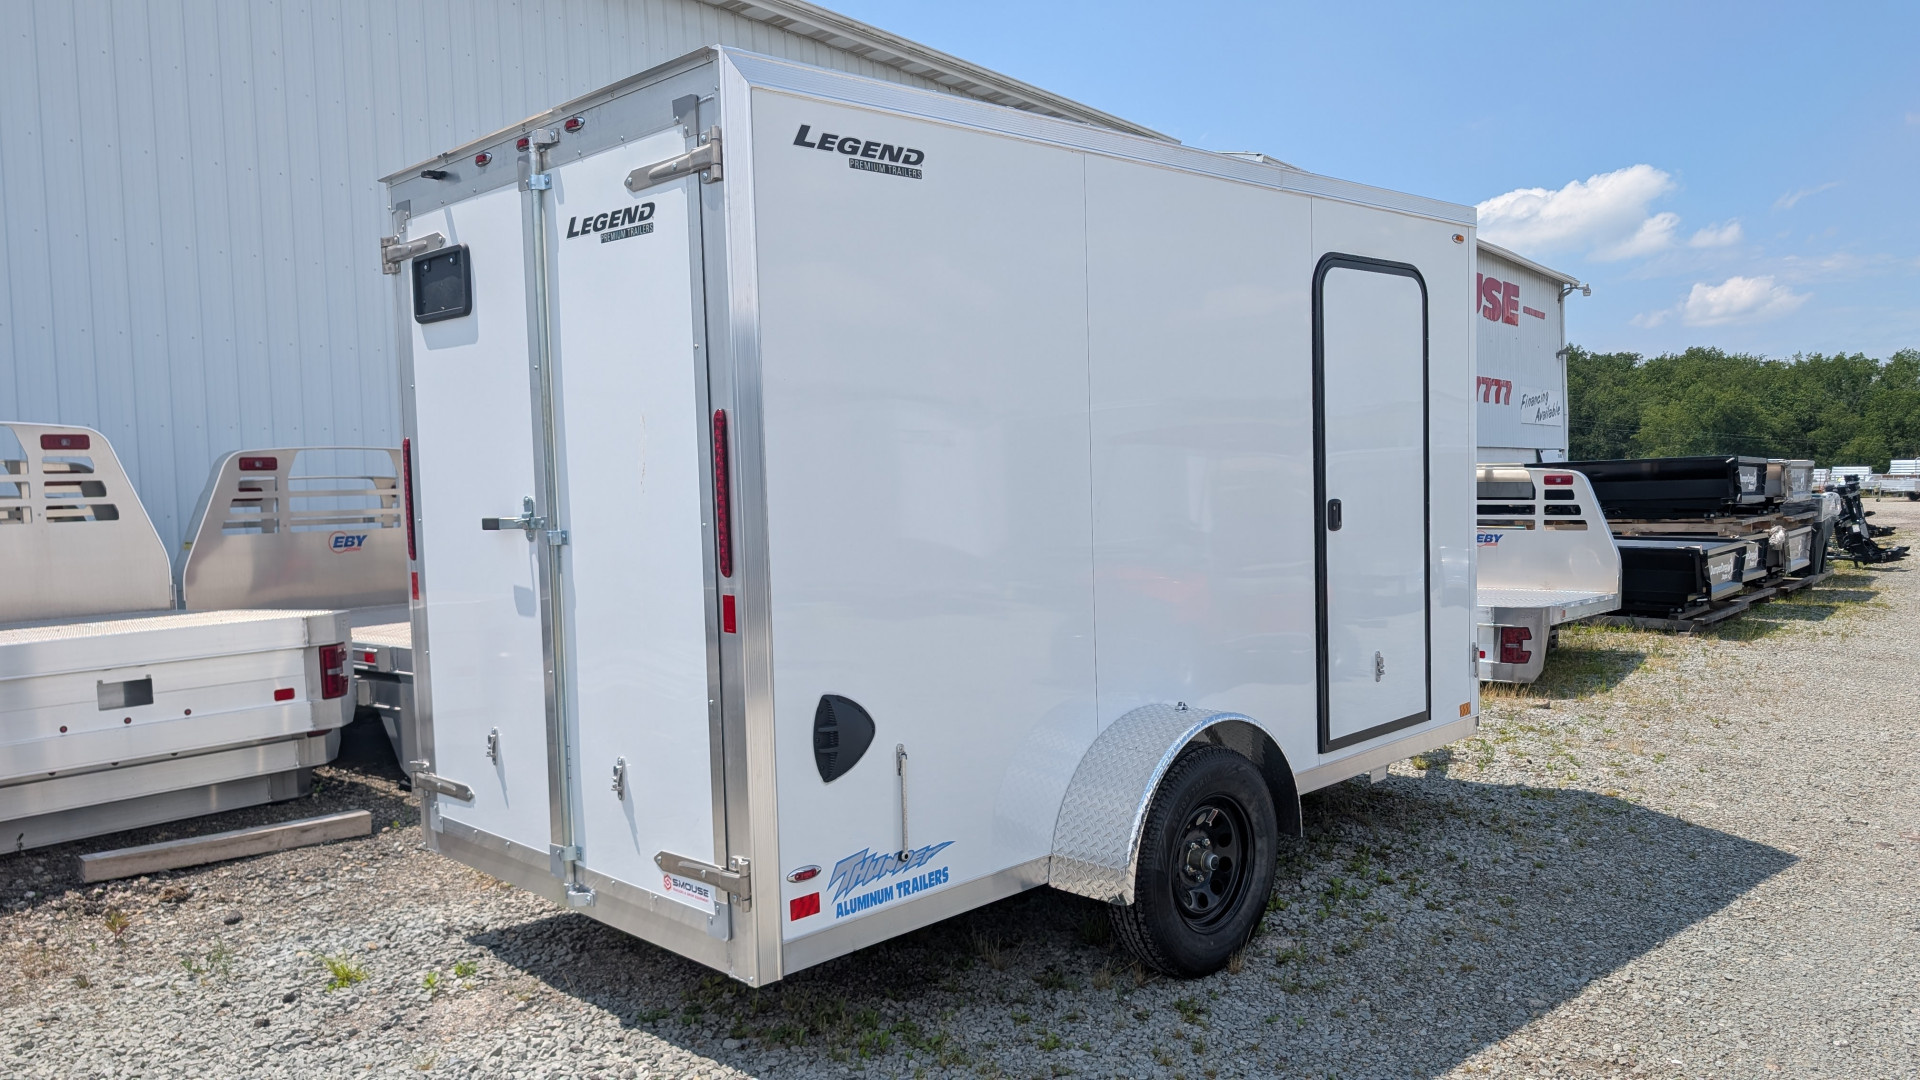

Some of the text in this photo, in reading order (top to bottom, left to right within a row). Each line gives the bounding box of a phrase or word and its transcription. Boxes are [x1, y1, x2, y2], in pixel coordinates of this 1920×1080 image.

[793, 124, 925, 166] LEGEND
[849, 158, 922, 179] PREMIUM TRAILERS
[567, 202, 655, 239] LEGEND
[601, 222, 654, 243] PREMIUM TRAILERS
[1521, 392, 1549, 410] Financing
[1535, 401, 1560, 423] Available
[333, 535, 367, 548] EBY
[1477, 534, 1504, 543] EBY
[836, 866, 949, 919] ALUMINUM TRAILERS
